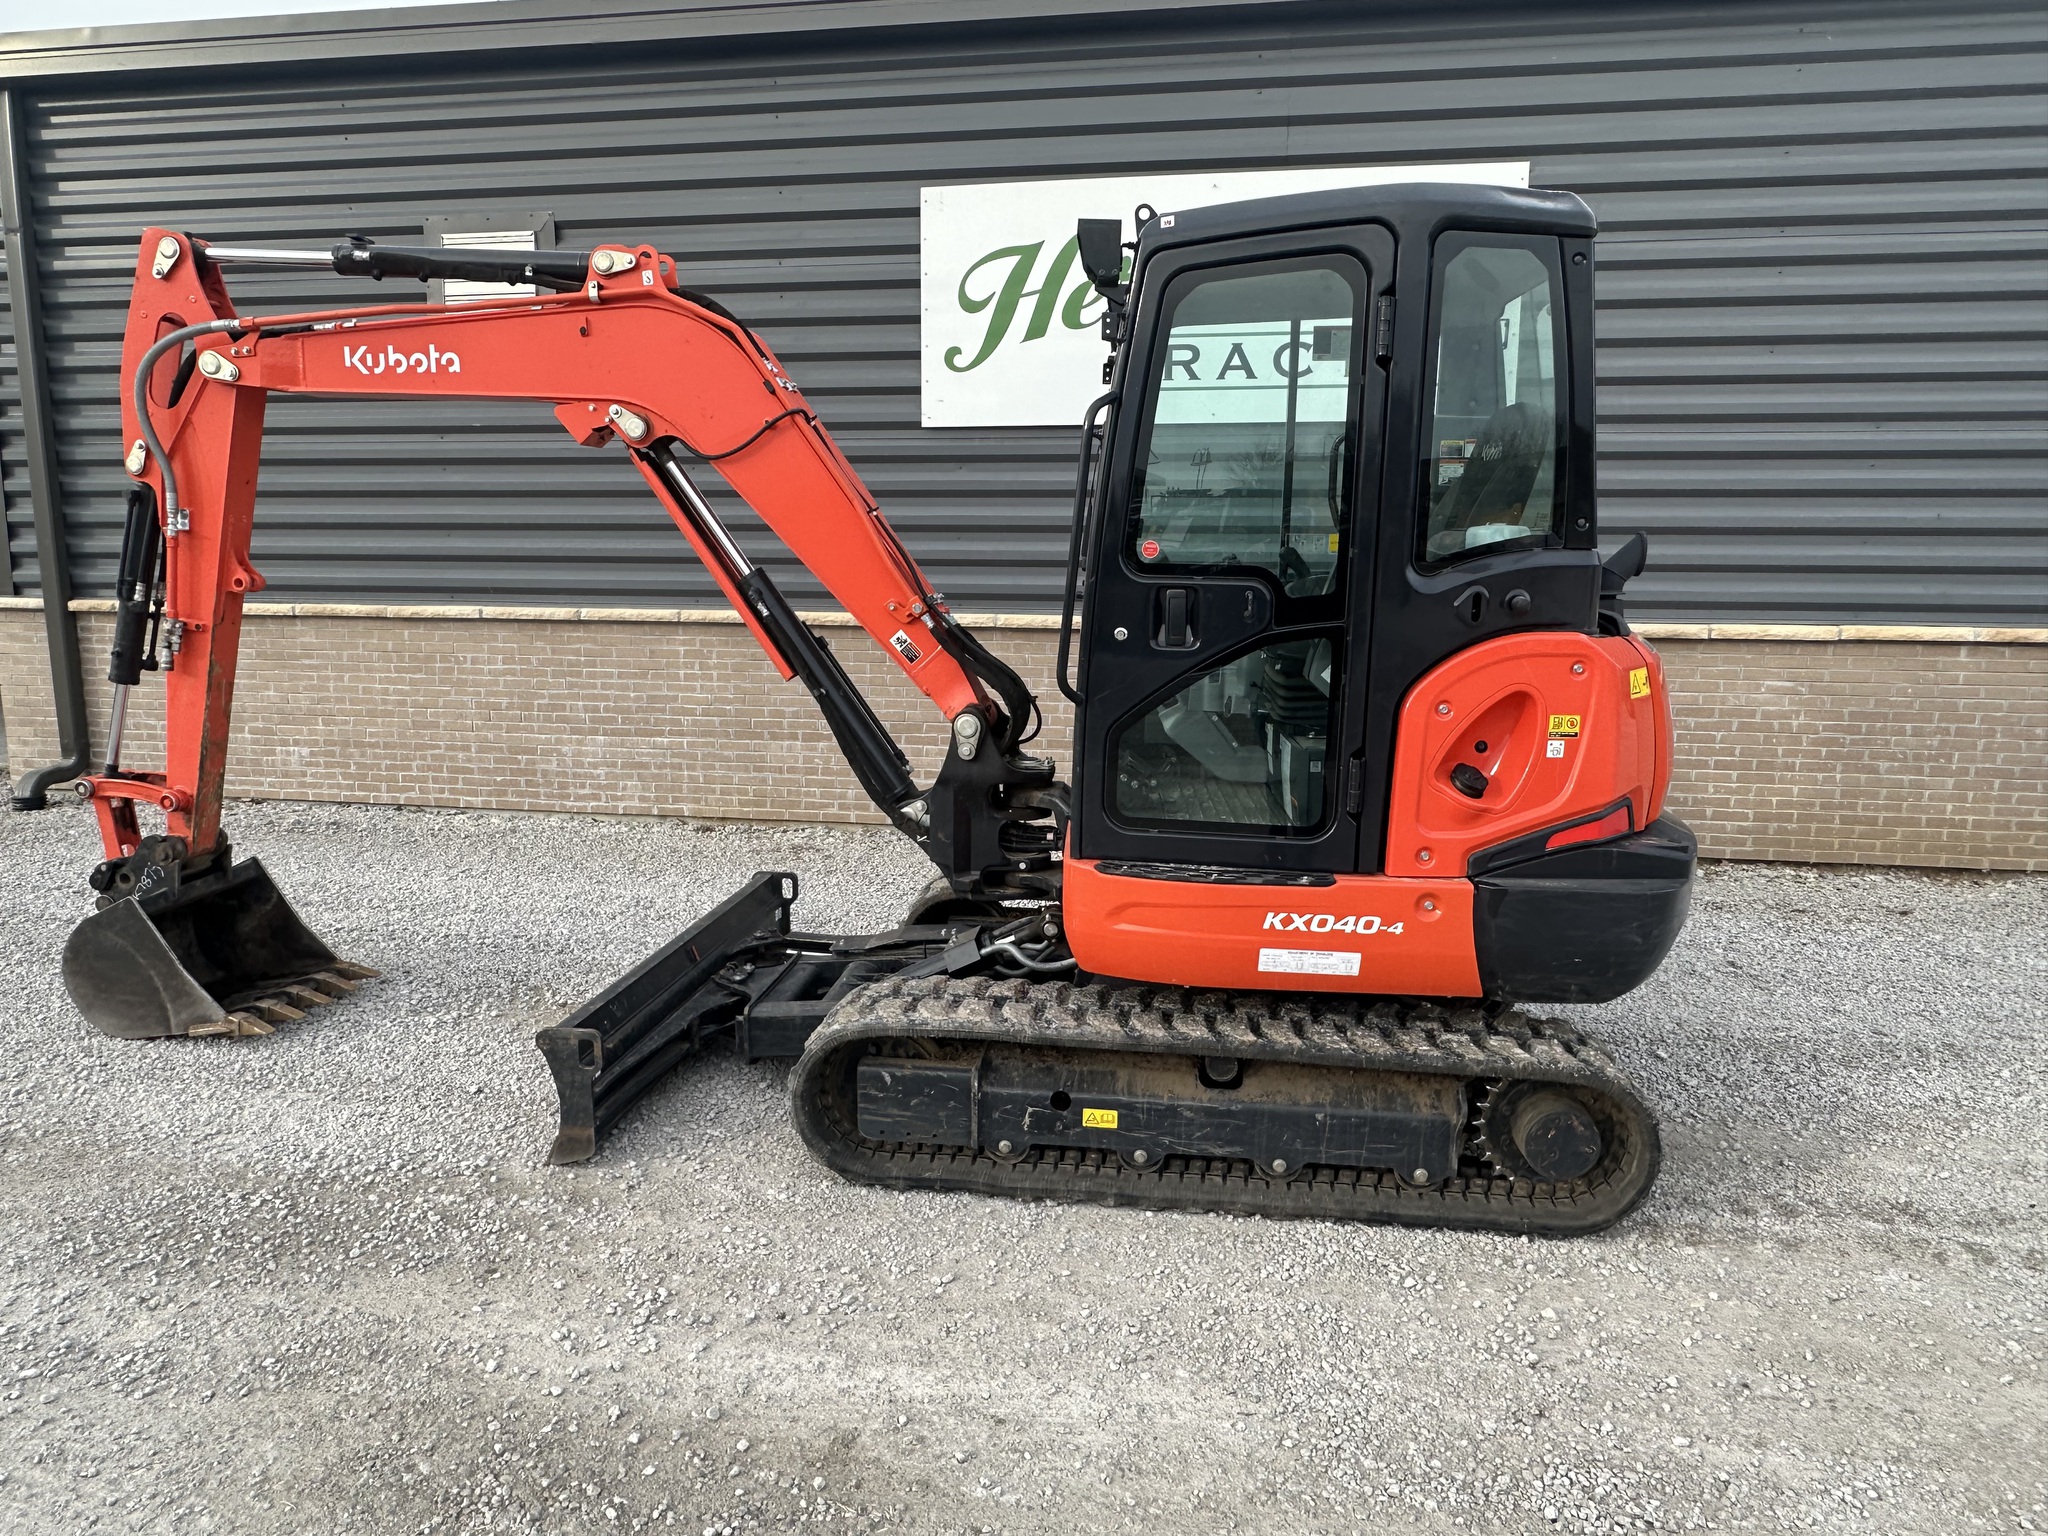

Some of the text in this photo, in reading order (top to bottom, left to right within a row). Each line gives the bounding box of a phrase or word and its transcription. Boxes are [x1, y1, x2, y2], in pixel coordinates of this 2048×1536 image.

[944, 236, 1132, 373] He
[343, 343, 461, 375] Kubota
[1163, 341, 1350, 382] RAC
[1262, 910, 1404, 936] KX040-4
